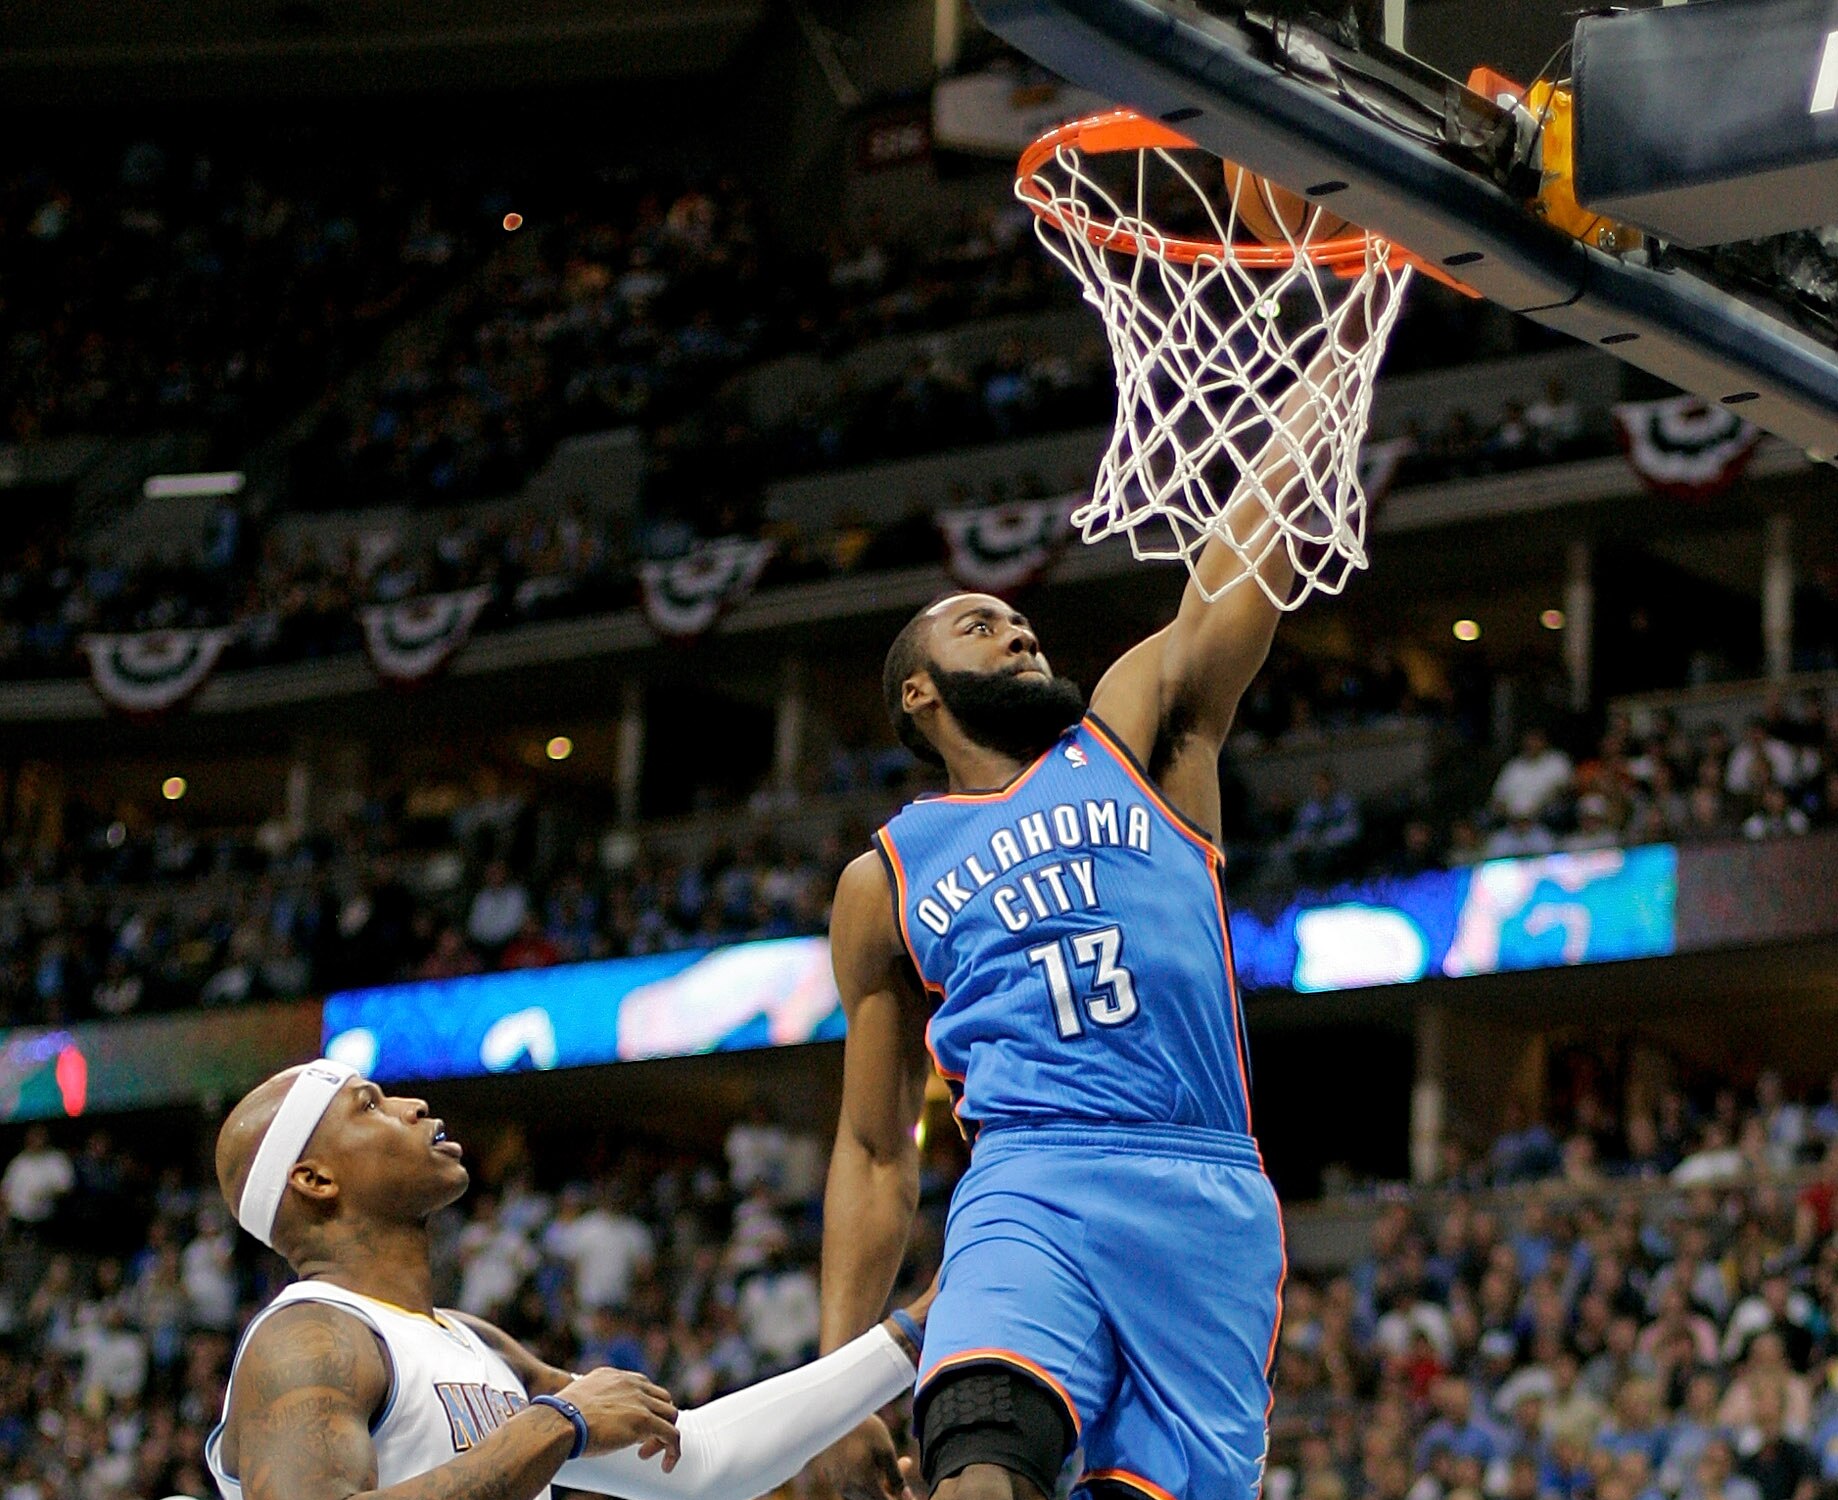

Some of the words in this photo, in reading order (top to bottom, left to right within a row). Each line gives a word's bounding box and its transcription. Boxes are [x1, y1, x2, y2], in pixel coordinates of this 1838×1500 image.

[917, 799, 1152, 937] OKLAHOMA
[994, 857, 1099, 934] CITY
[1027, 923, 1138, 1041] 13
